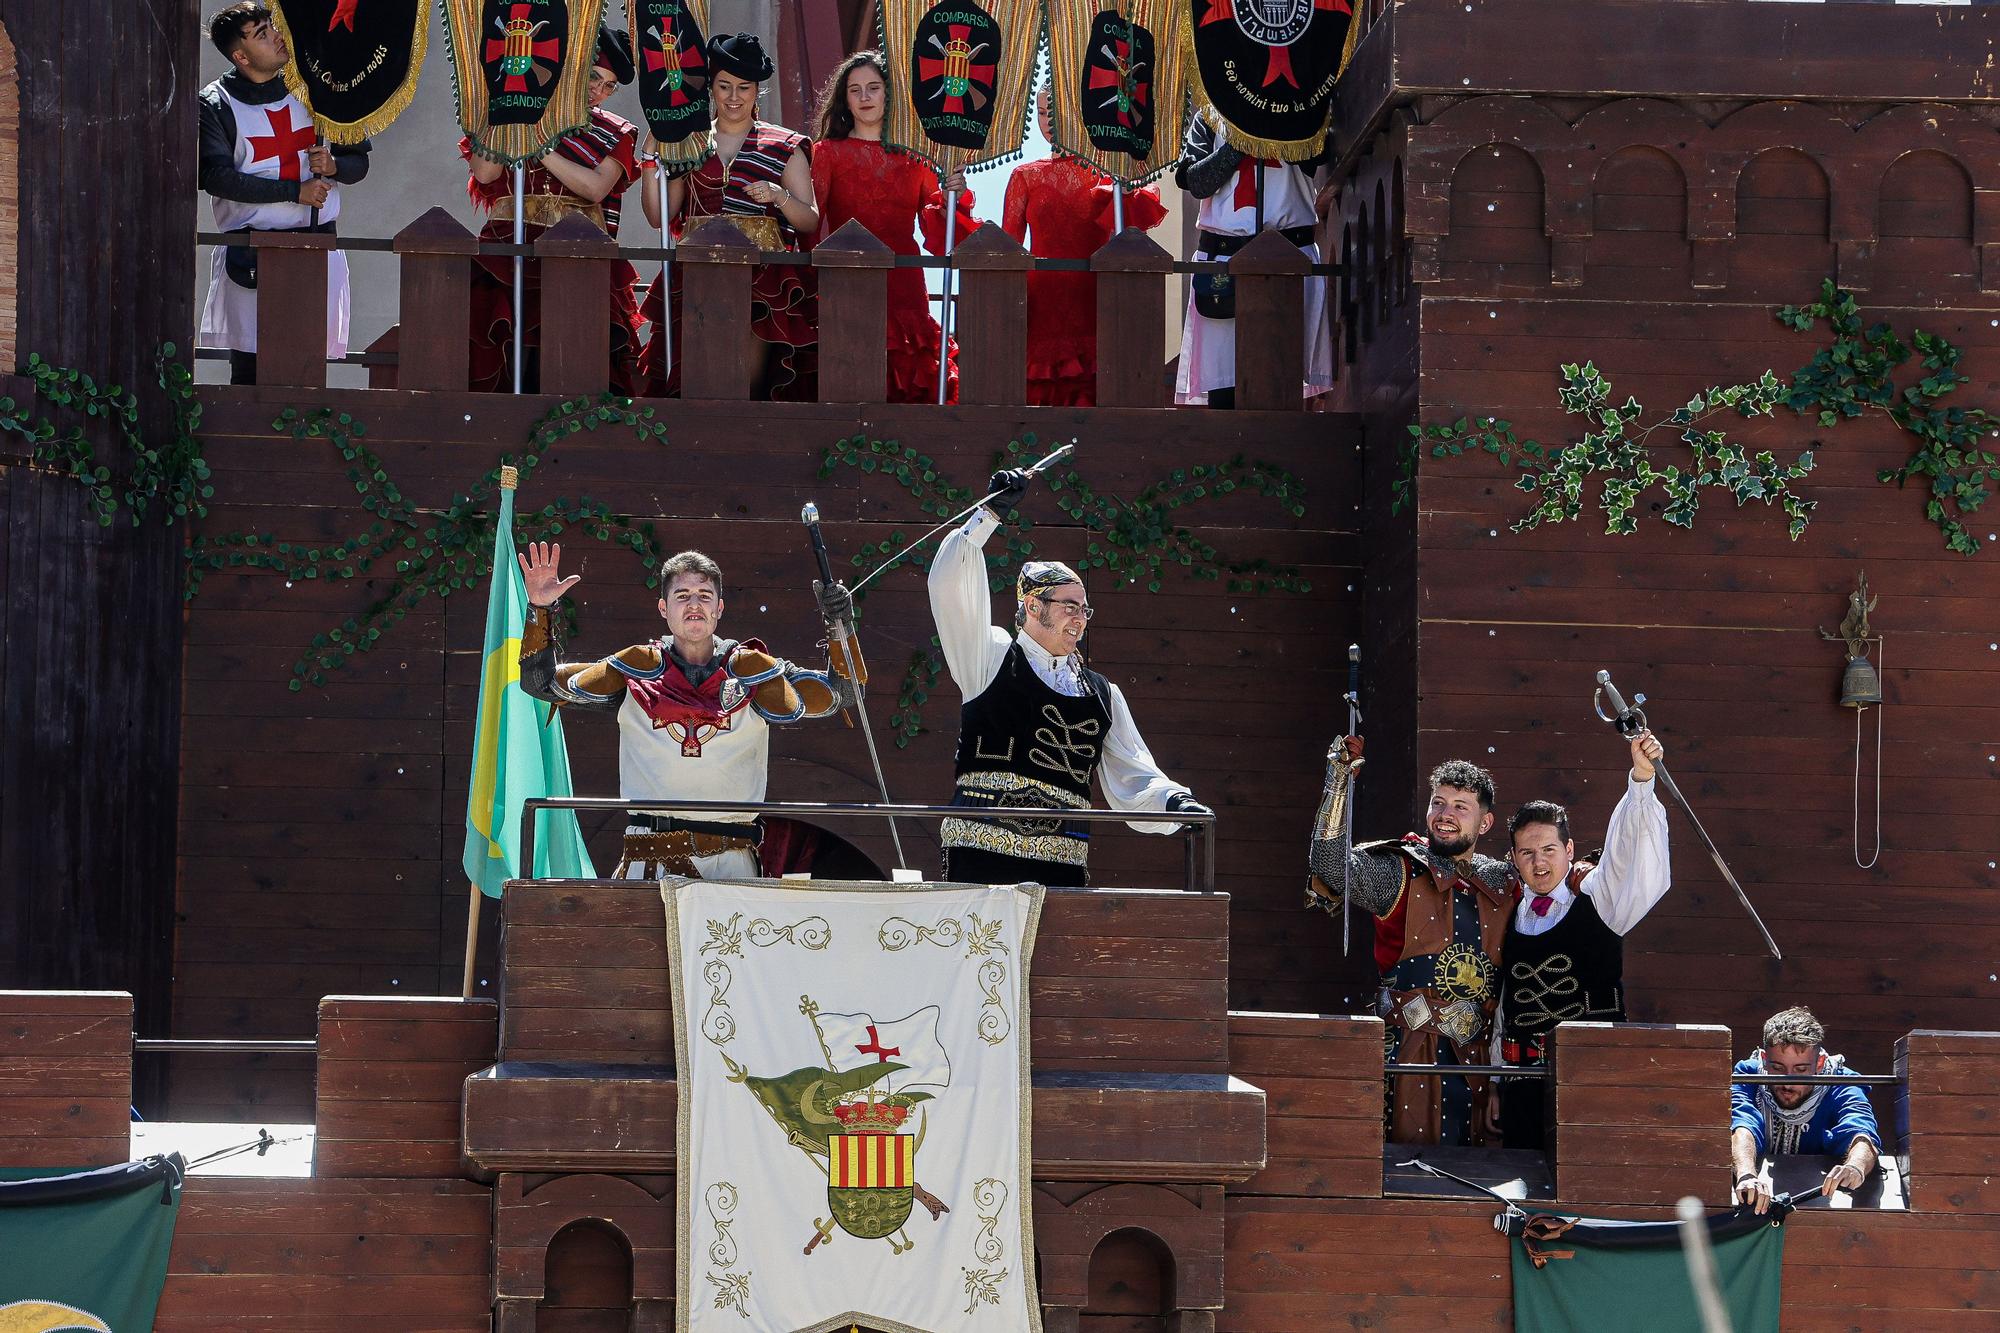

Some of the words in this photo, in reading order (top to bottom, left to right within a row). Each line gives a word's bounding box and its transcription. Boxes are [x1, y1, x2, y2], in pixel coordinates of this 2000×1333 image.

[933, 11, 990, 29] COMPARSA
[351, 71, 366, 88] non
[366, 44, 388, 74] nobis
[1235, 81, 1268, 110] nomini
